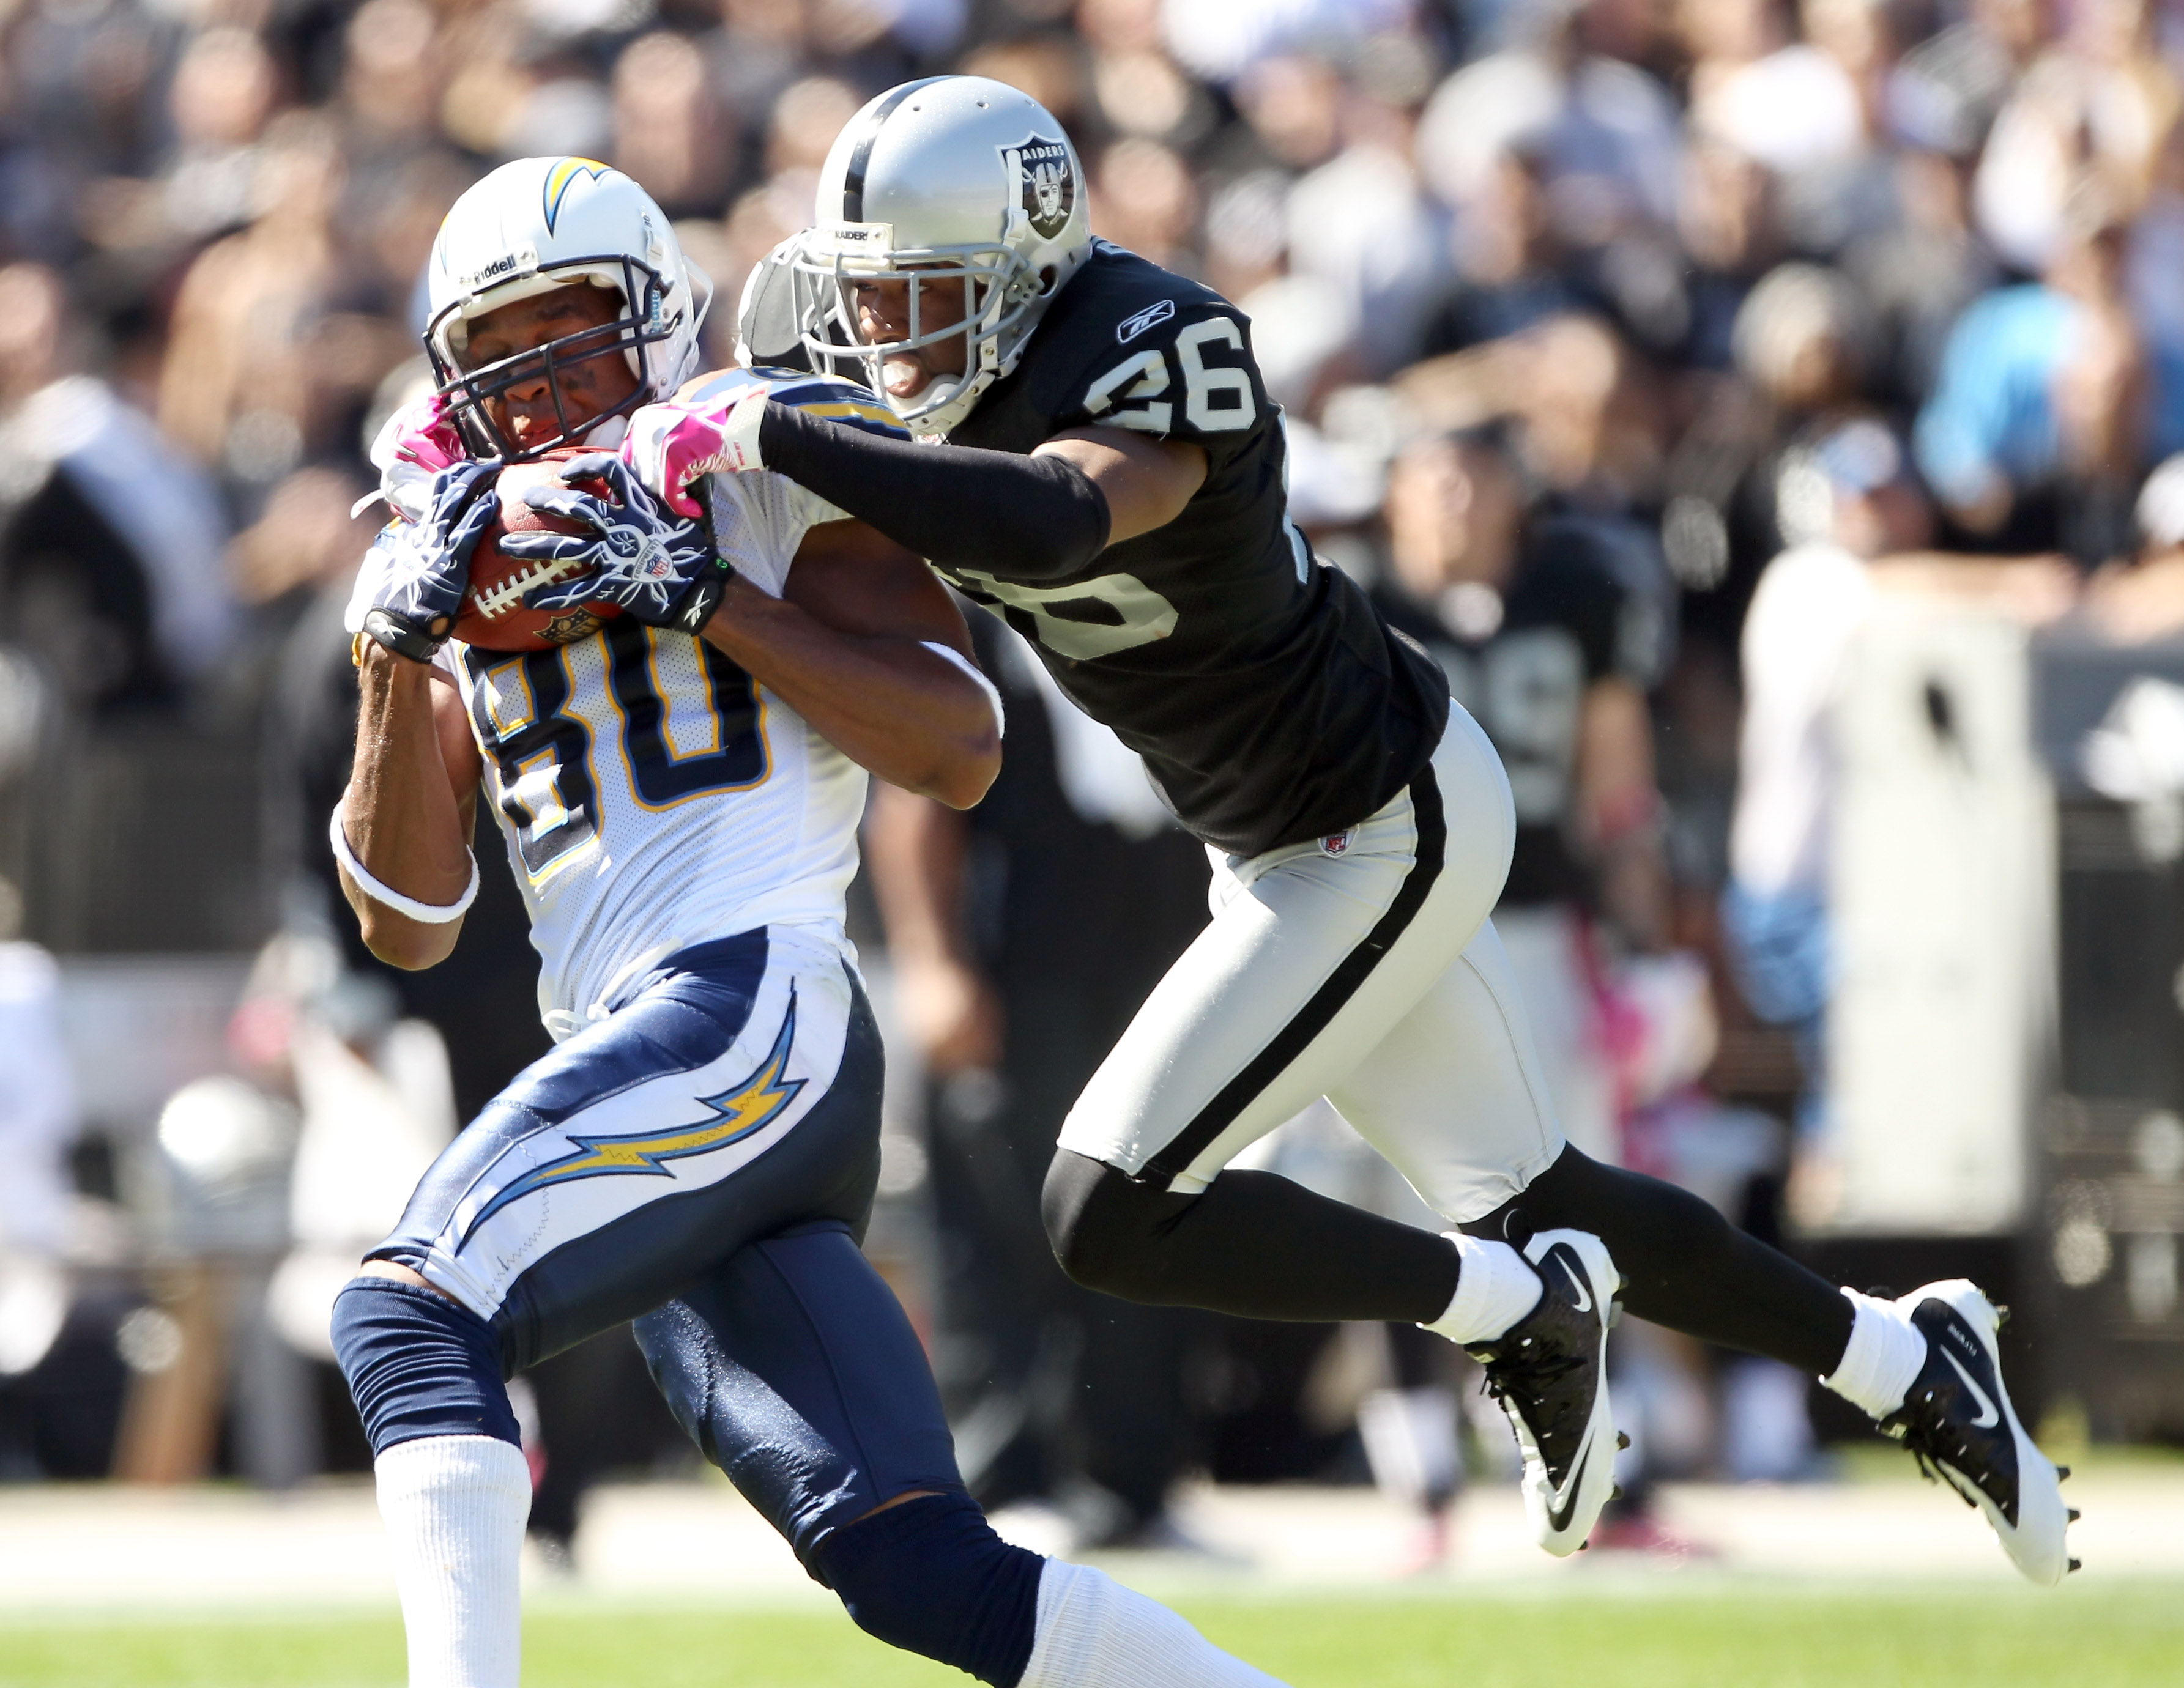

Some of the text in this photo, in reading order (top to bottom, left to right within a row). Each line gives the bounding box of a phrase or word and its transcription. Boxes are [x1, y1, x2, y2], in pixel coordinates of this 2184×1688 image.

[1022, 145, 1064, 160] AIDERS
[1083, 317, 1257, 434] 26
[458, 612, 773, 886] 80
